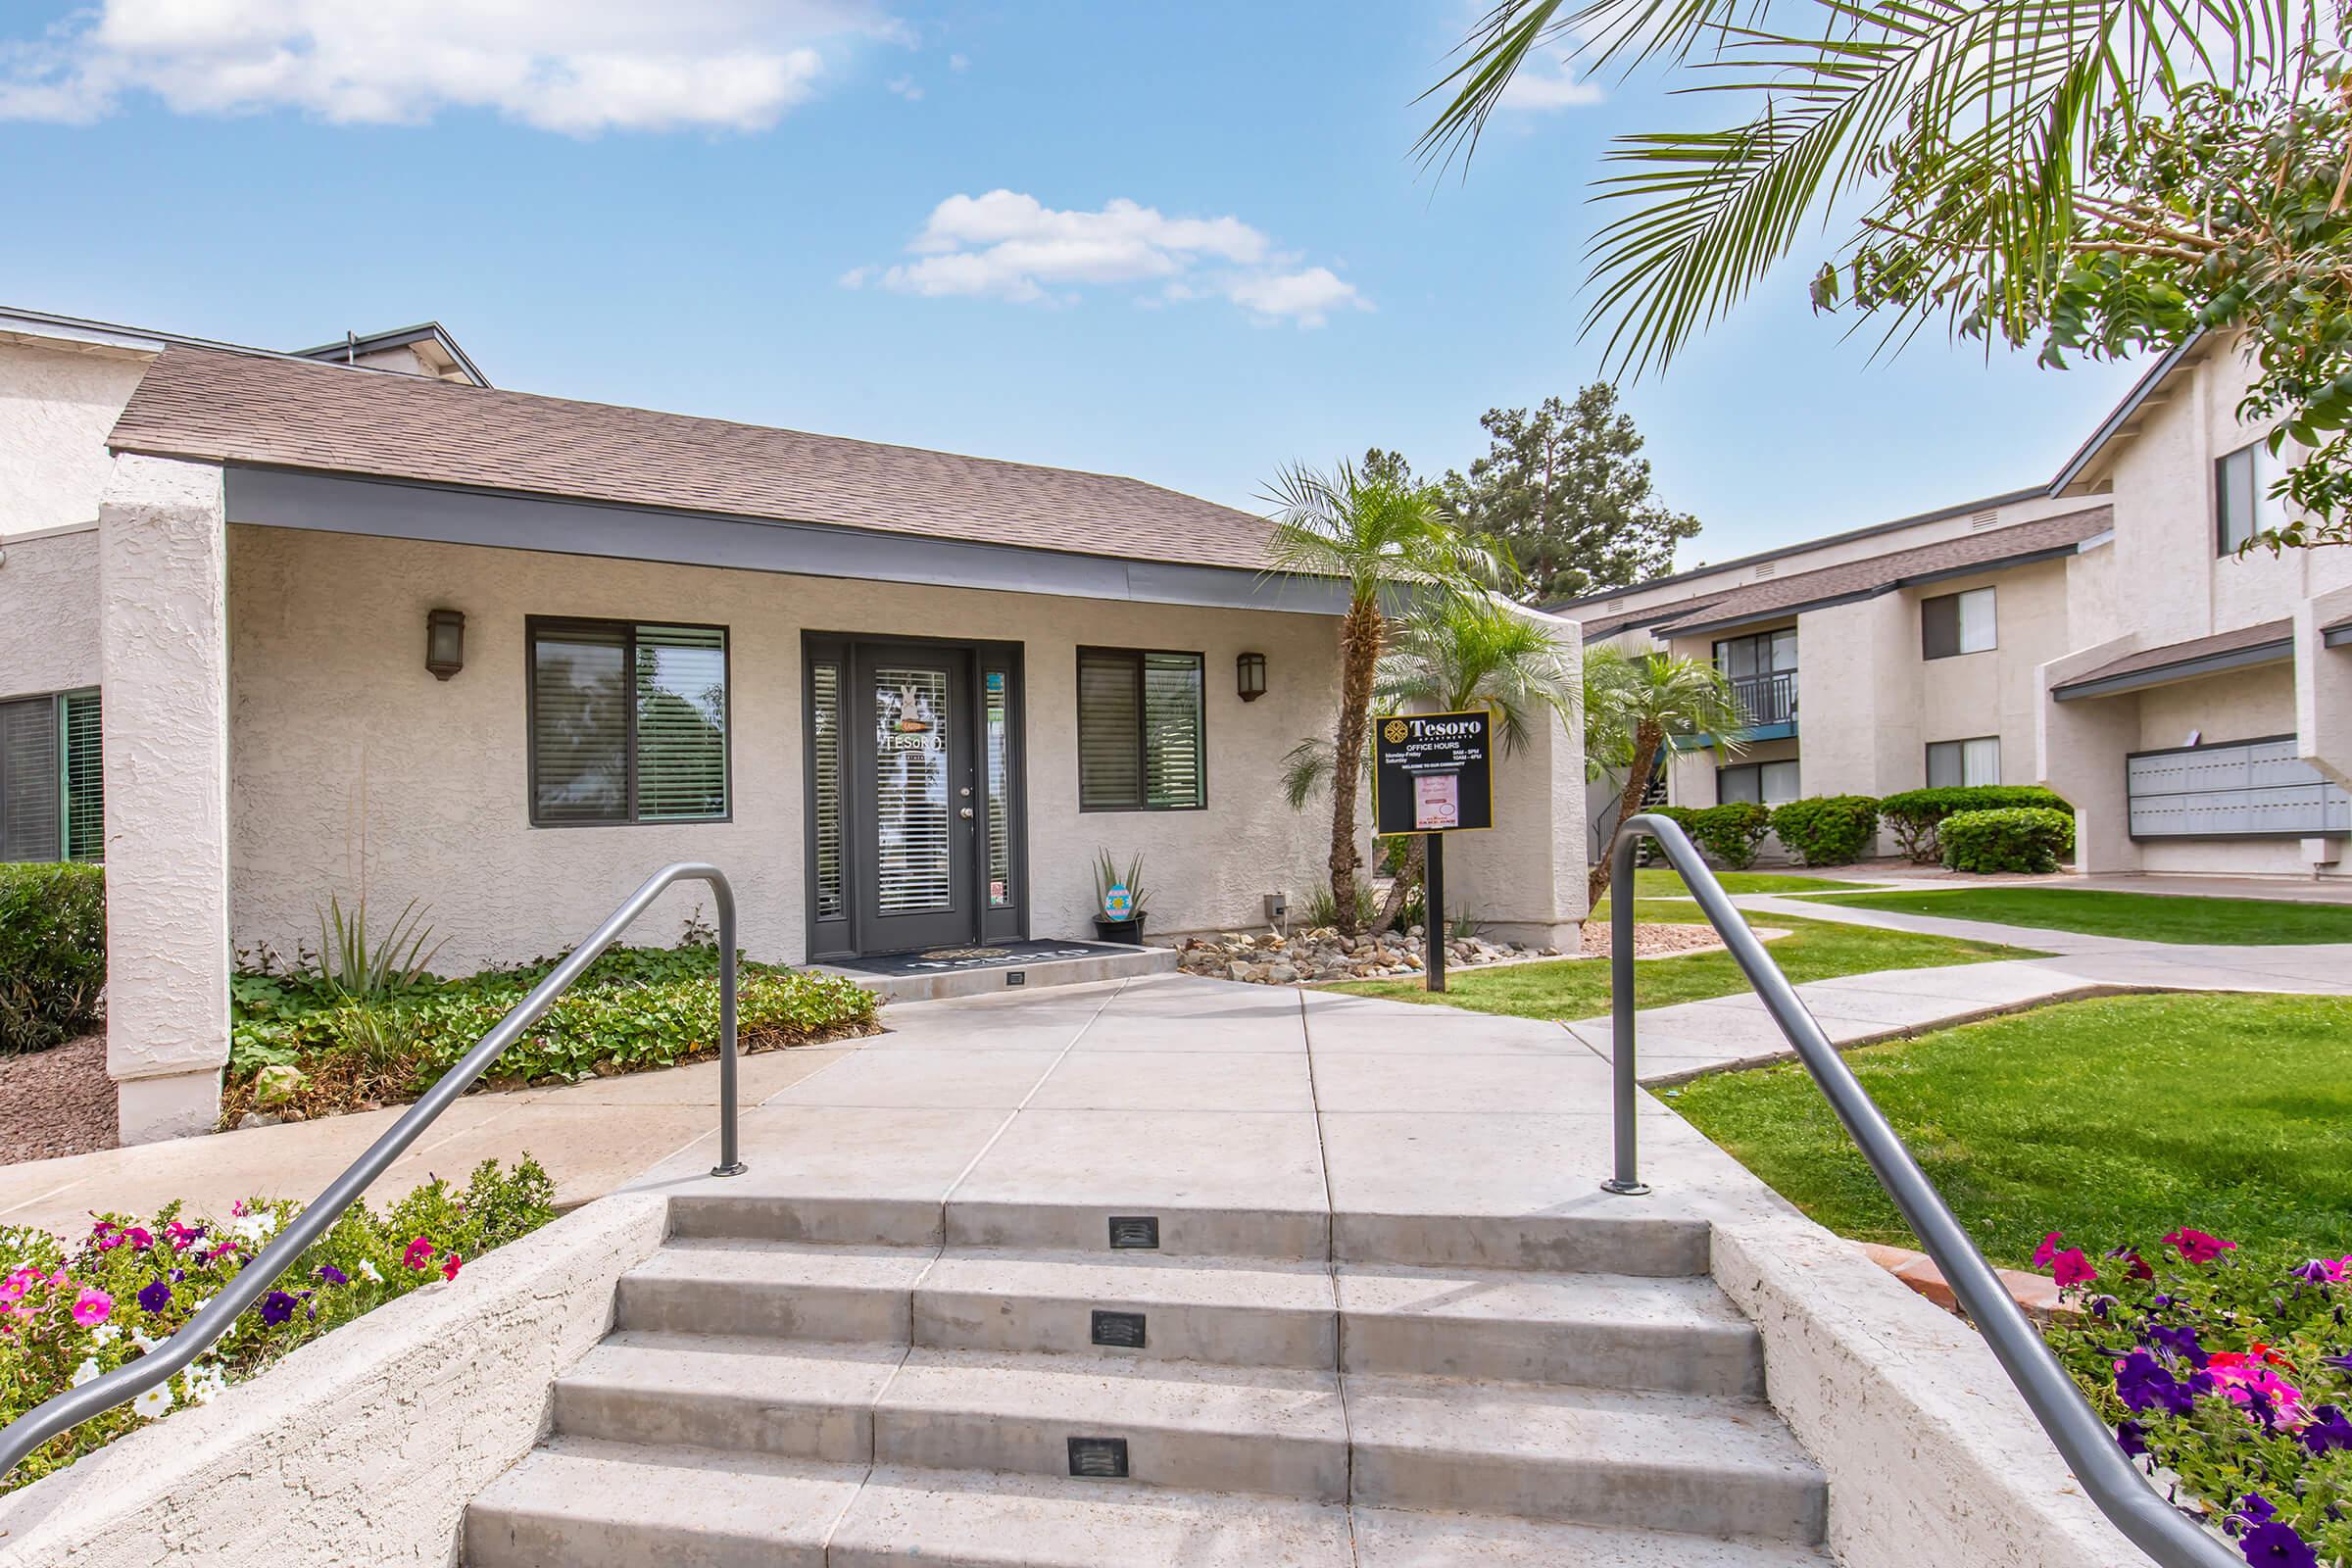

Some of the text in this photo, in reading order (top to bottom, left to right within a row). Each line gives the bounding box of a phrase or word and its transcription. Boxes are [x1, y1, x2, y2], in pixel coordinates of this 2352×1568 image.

[1409, 719, 1482, 737] Tesoro
[1406, 742, 1460, 752] OFFICE HOURS
